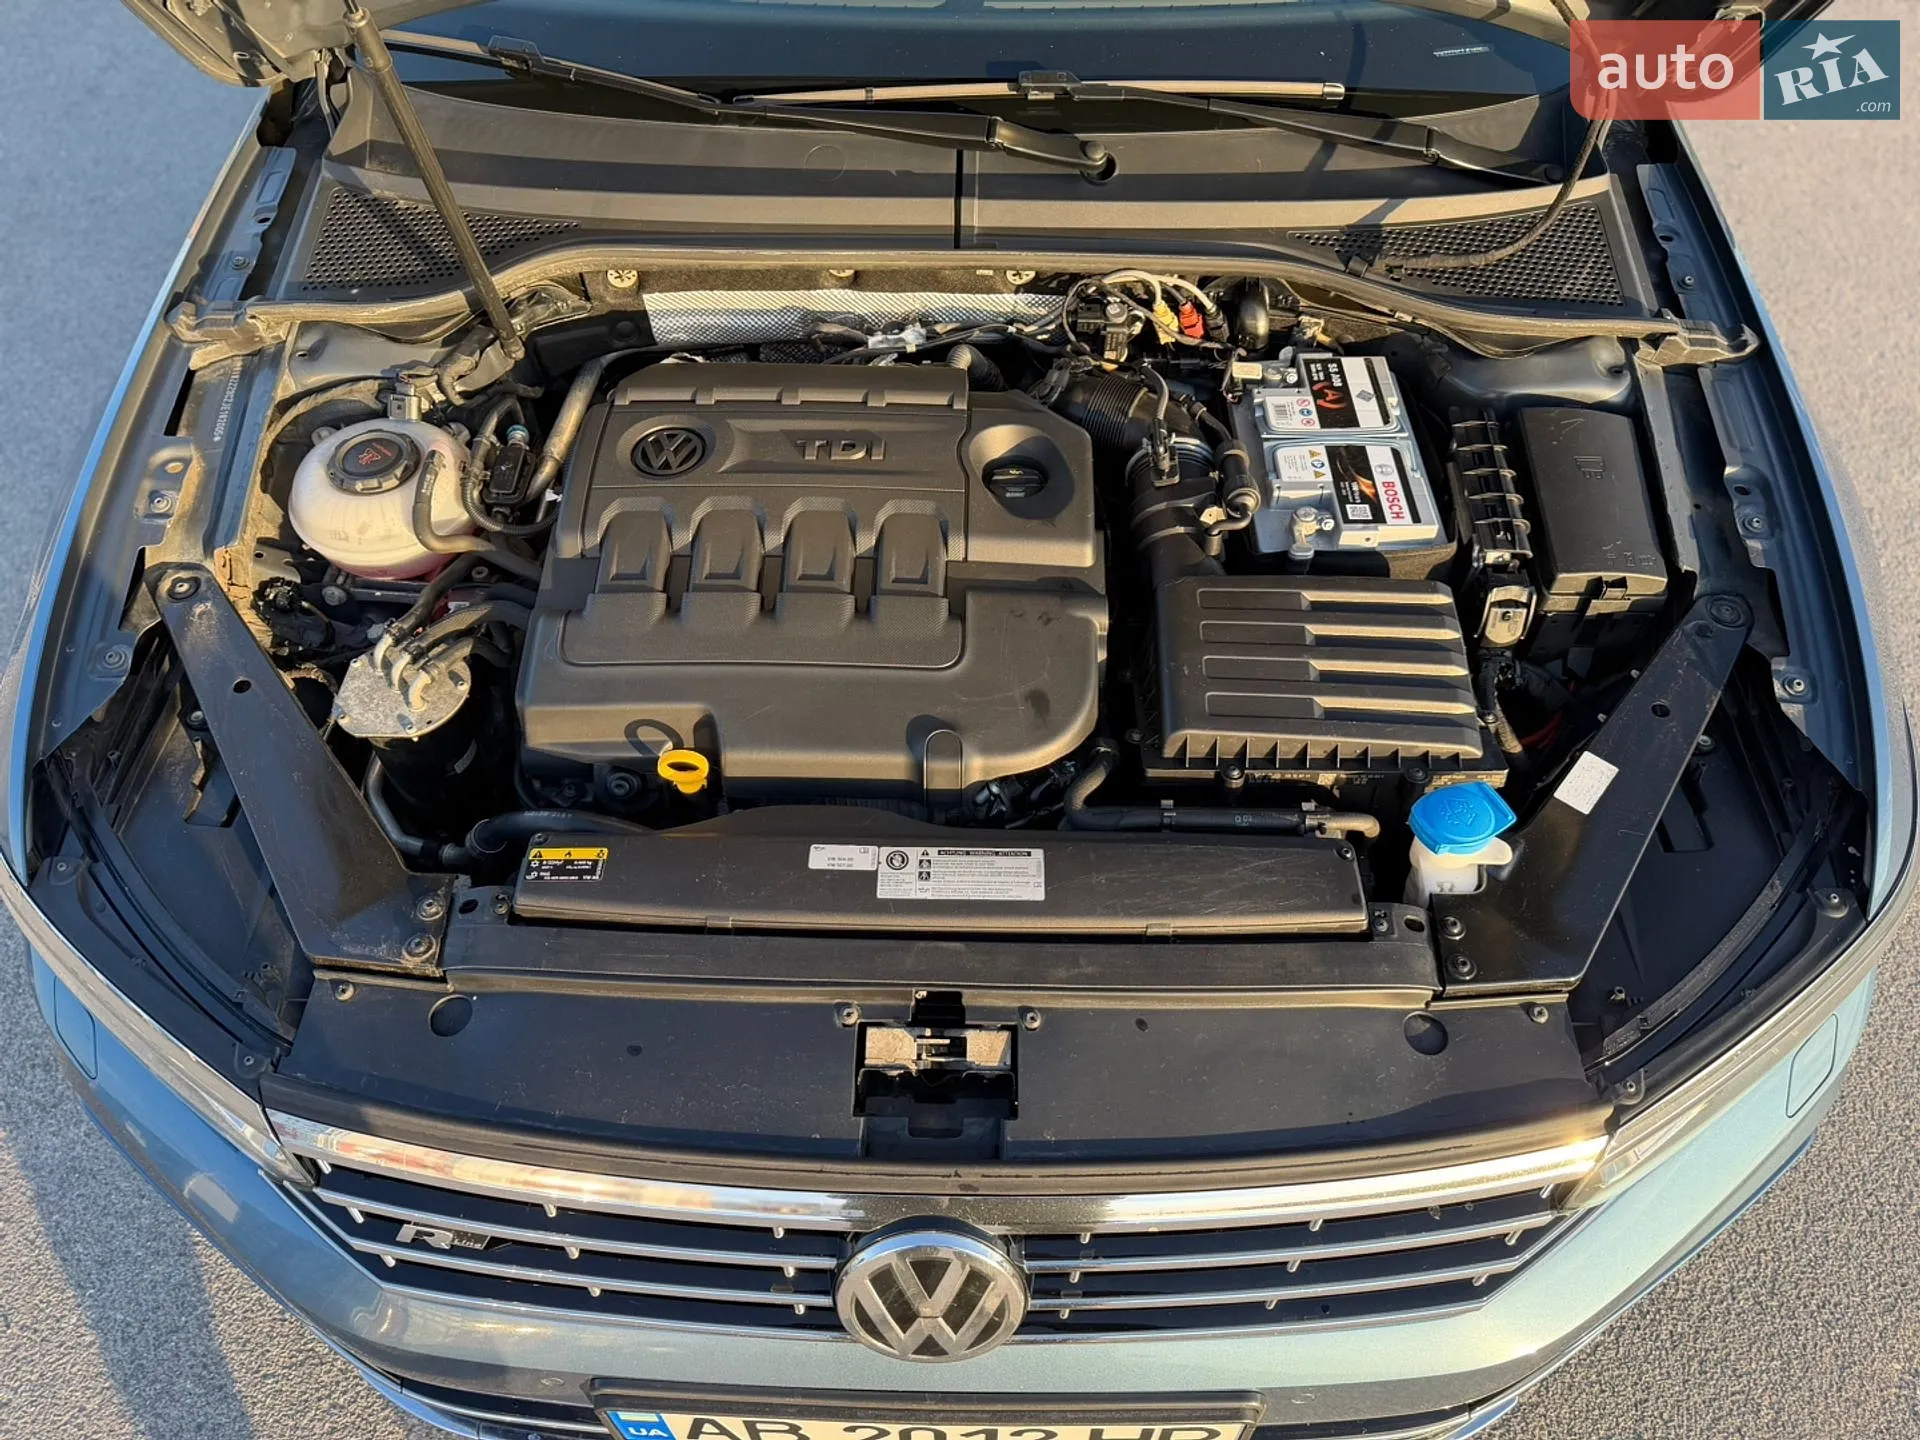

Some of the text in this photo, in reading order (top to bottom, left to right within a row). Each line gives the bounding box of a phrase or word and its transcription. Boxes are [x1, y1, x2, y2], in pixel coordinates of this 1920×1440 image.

[796, 439, 887, 460] TDI
[1381, 481, 1405, 520] BOSCH
[628, 1426, 668, 1438] UA
[686, 1418, 811, 1440] AB
